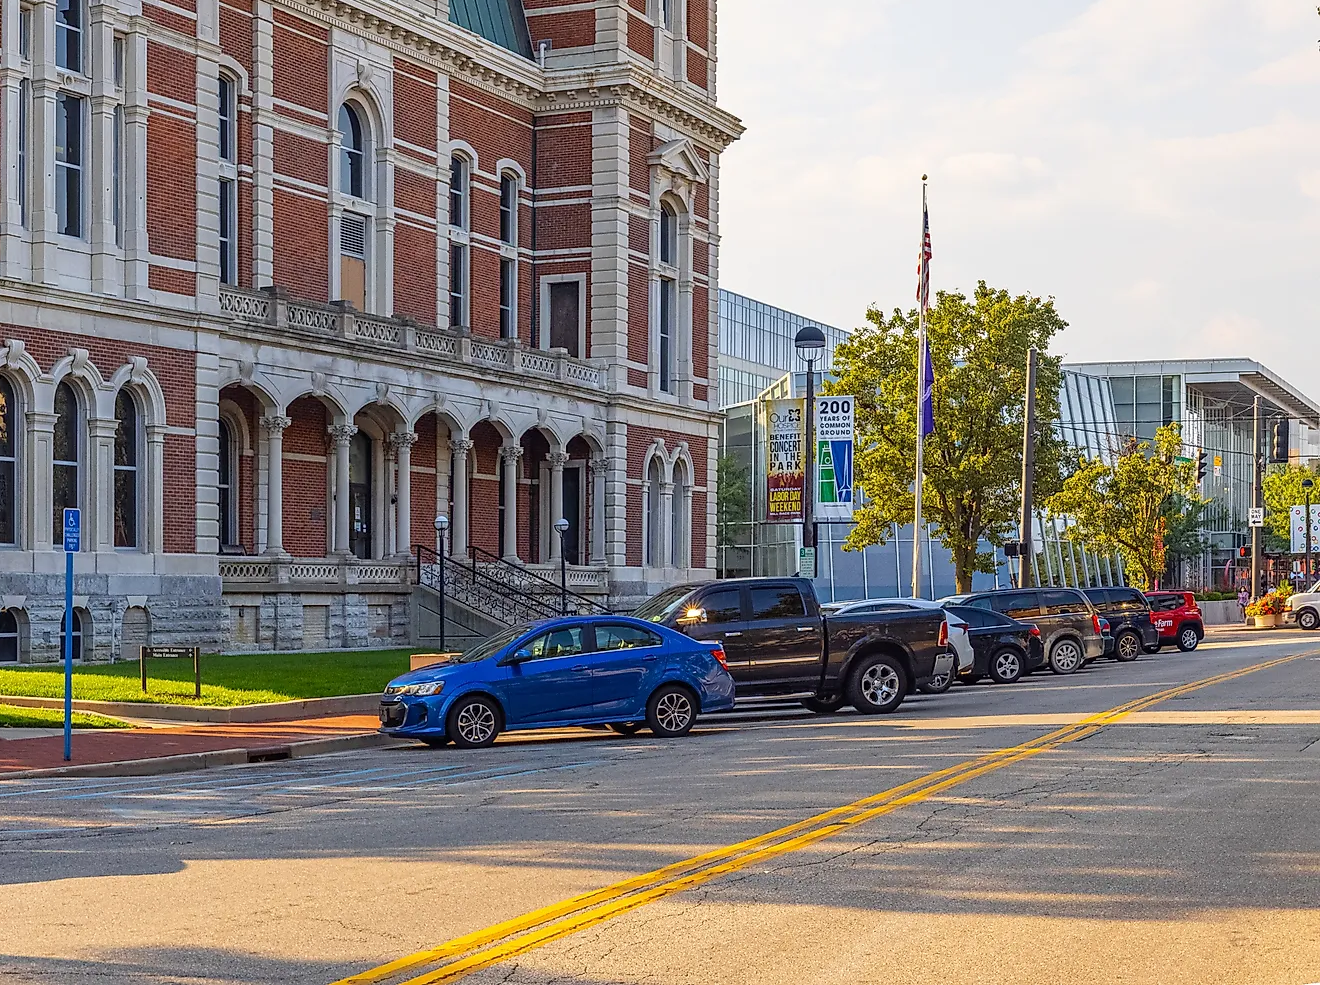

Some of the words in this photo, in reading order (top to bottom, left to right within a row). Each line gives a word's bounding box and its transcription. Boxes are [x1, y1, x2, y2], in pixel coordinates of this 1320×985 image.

[820, 401, 850, 414] 200
[770, 413, 788, 423] Our
[770, 440, 801, 452] CONCERT
[770, 453, 779, 461] IN
[784, 452, 801, 461] THE
[770, 461, 801, 471] PARK
[770, 492, 789, 501] LABOR
[790, 491, 801, 500] DAY
[770, 502, 801, 512] WEEKEND
